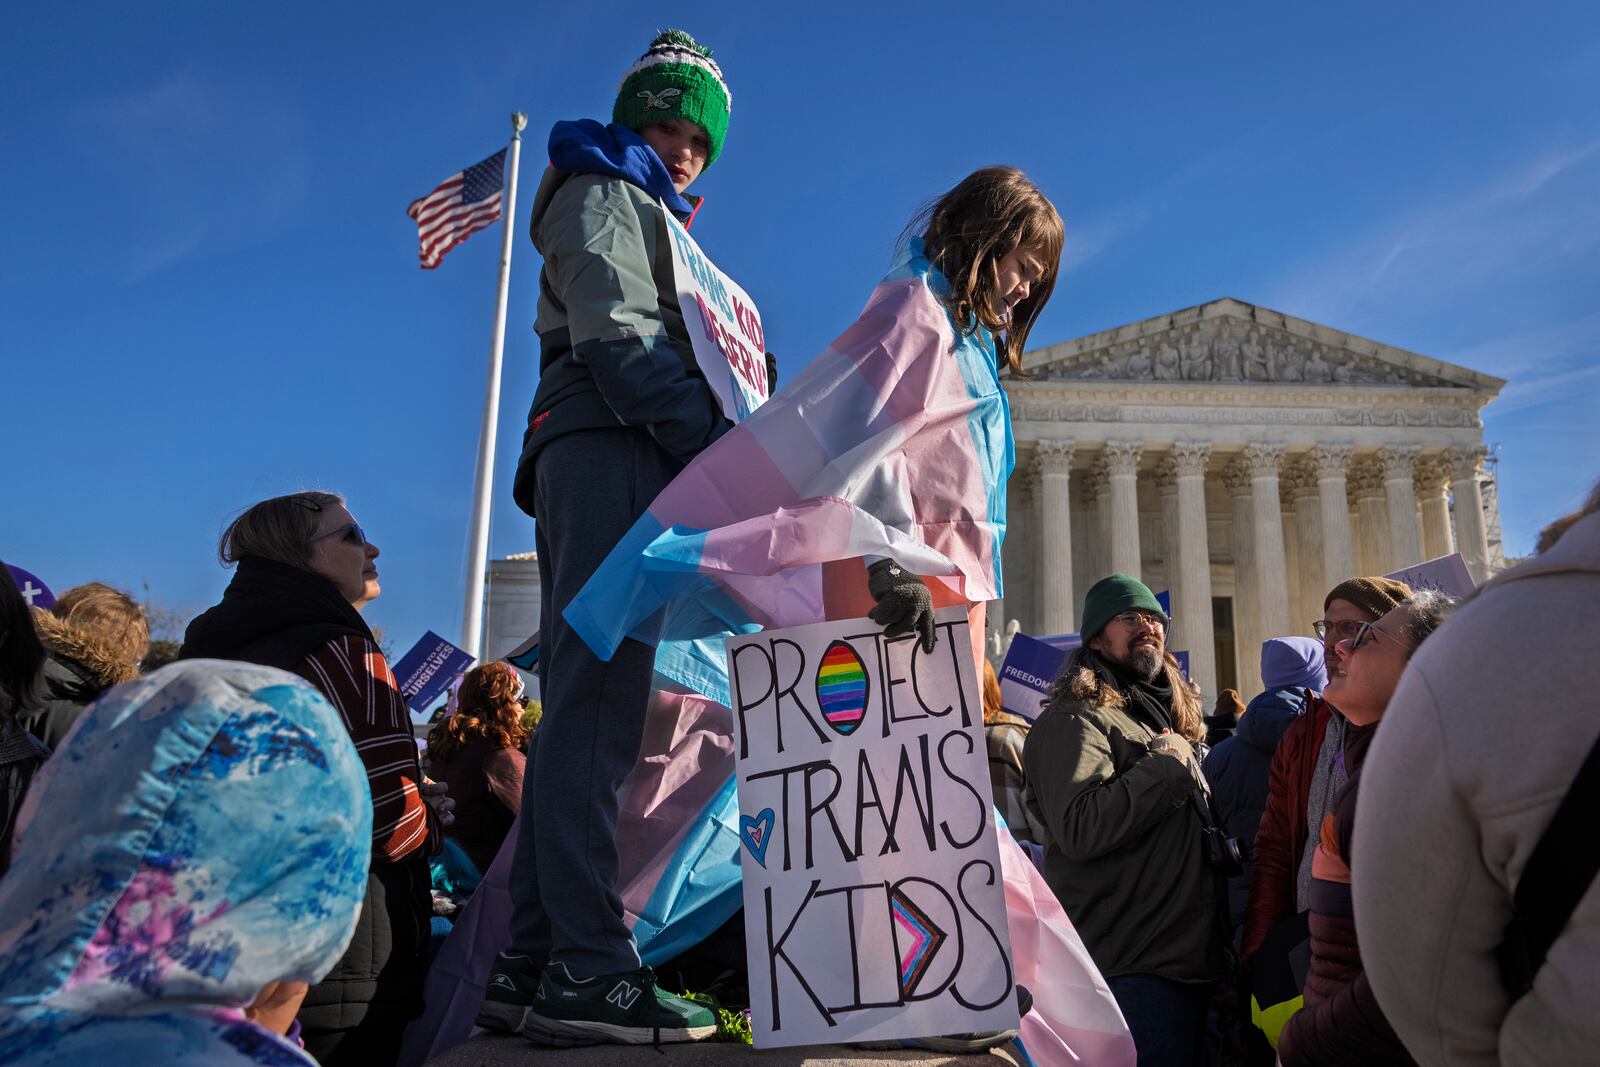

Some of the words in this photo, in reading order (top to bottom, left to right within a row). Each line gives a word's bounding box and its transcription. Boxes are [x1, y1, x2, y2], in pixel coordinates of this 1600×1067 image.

[665, 213, 734, 324] TRANS
[731, 620, 969, 760] PROTECT
[746, 729, 987, 871] TRANS
[763, 859, 1013, 1031] KIDS
